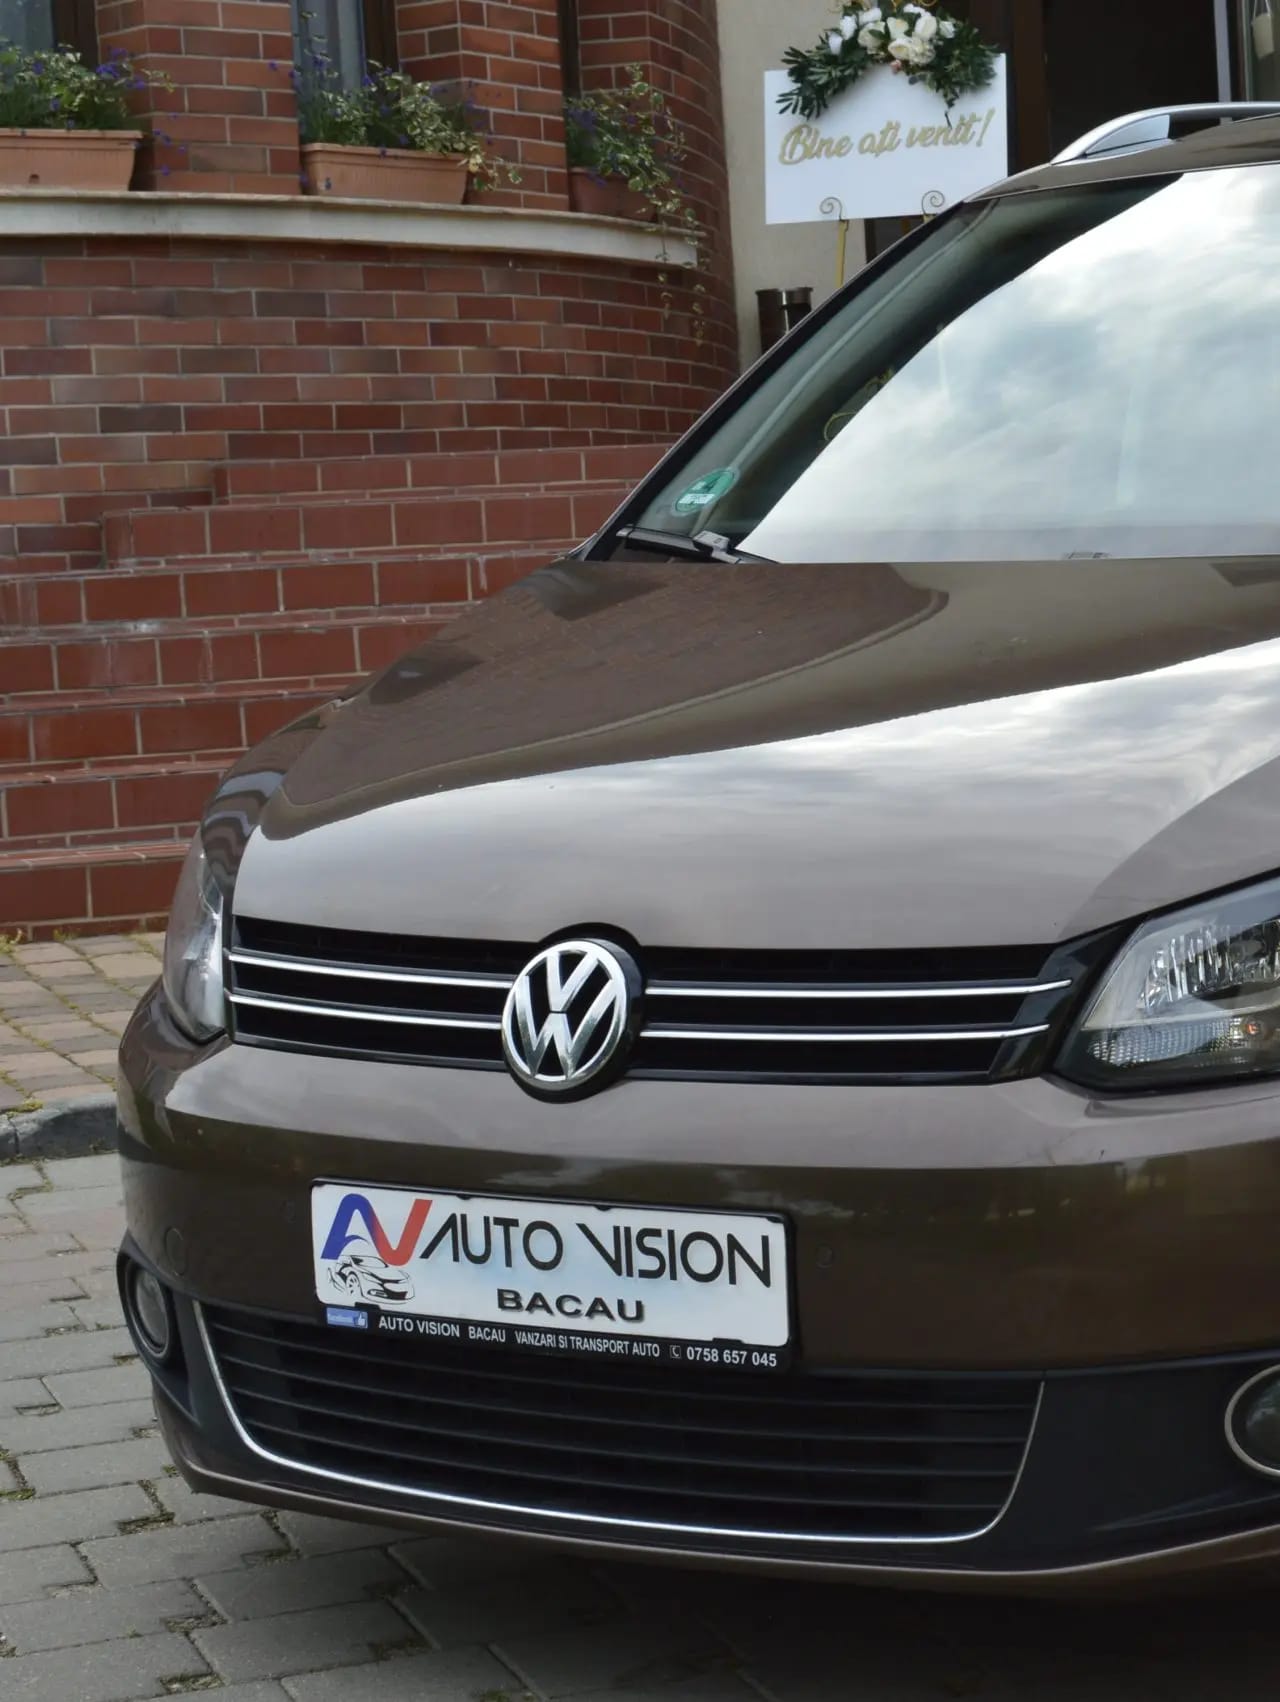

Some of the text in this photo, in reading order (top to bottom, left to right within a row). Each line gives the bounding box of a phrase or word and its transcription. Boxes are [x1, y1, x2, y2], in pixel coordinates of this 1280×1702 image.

[779, 123, 853, 166] Bine
[508, 944, 622, 1084] VW
[420, 1212, 771, 1288] AUTO VISION
[497, 1288, 645, 1324] BACAU
[378, 1315, 778, 1368] AUTO VISION BACAU VANZARI SI TRANSPORT AUTO 0758 657 045
